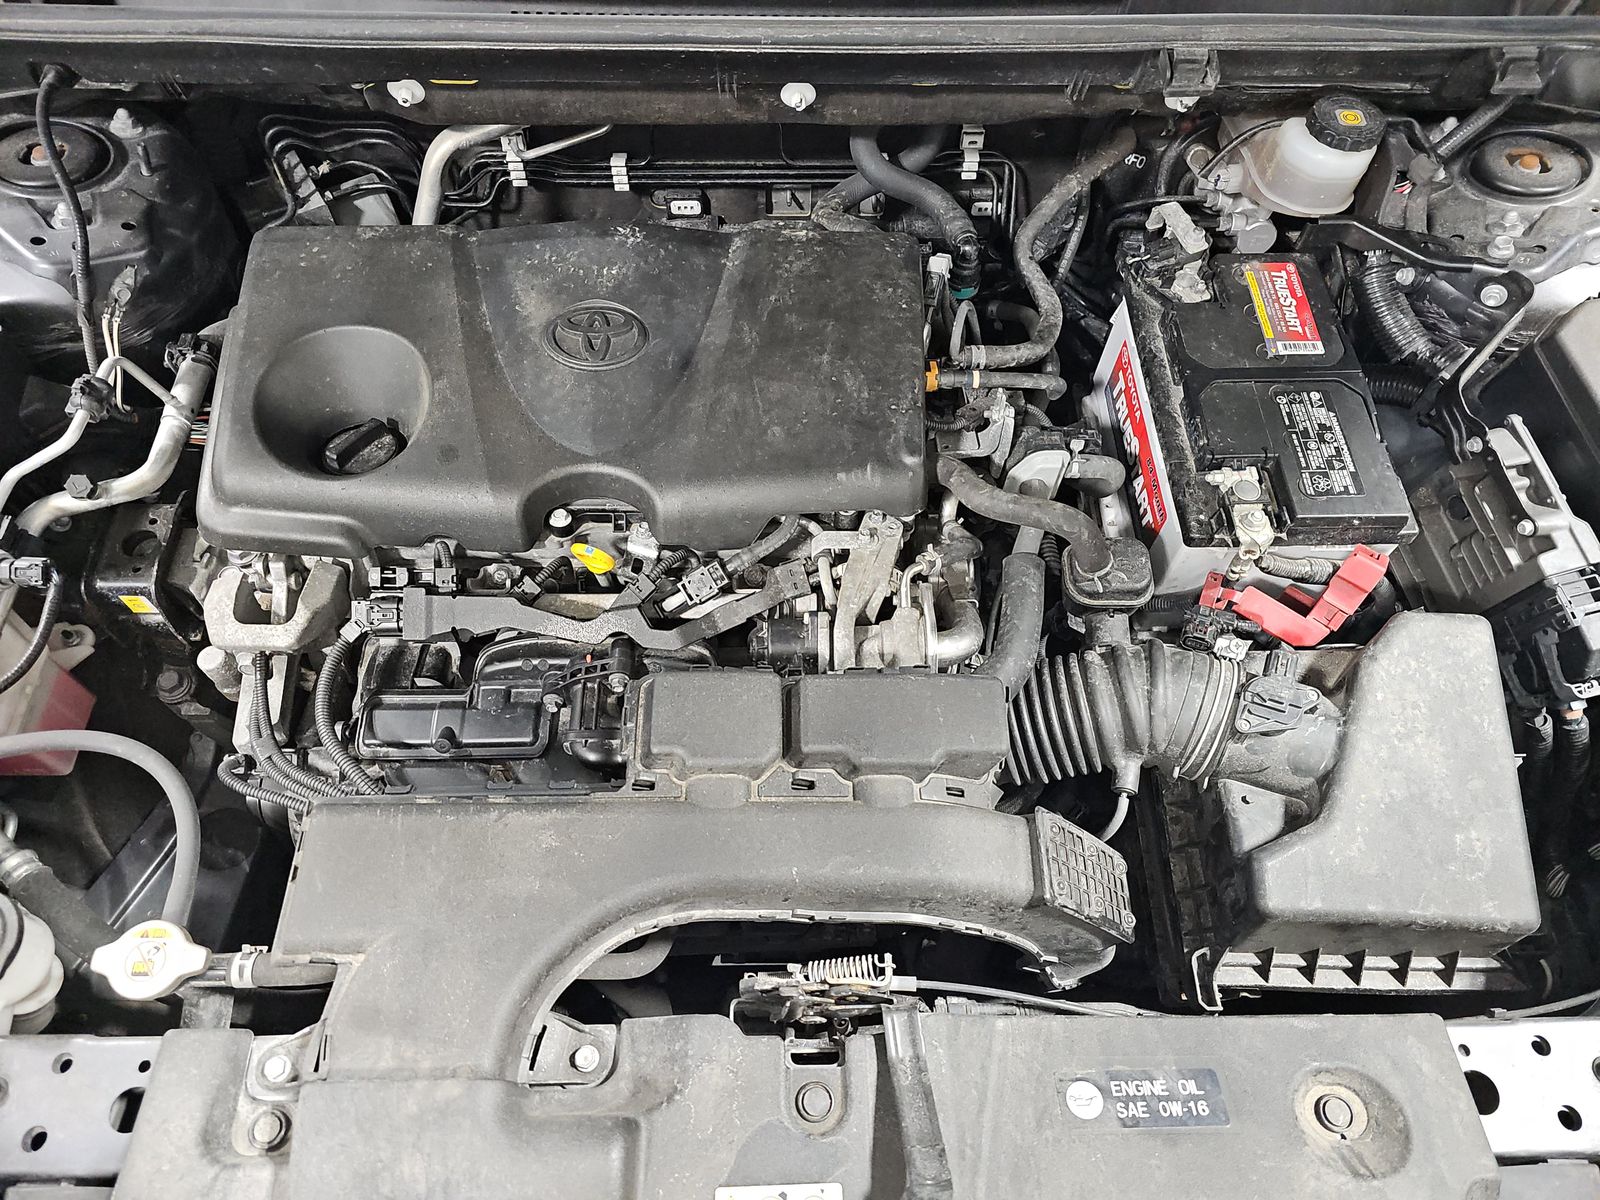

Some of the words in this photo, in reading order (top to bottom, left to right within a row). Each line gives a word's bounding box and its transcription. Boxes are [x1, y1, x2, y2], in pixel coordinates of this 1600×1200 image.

[1291, 273, 1303, 298] TOYOTA
[1126, 366, 1141, 424] TOYOTA
[1110, 1080, 1169, 1096] ENGINE
[1178, 1079, 1205, 1095] OIL
[1116, 1102, 1150, 1118] SAE
[1159, 1100, 1210, 1117] 0W-16
